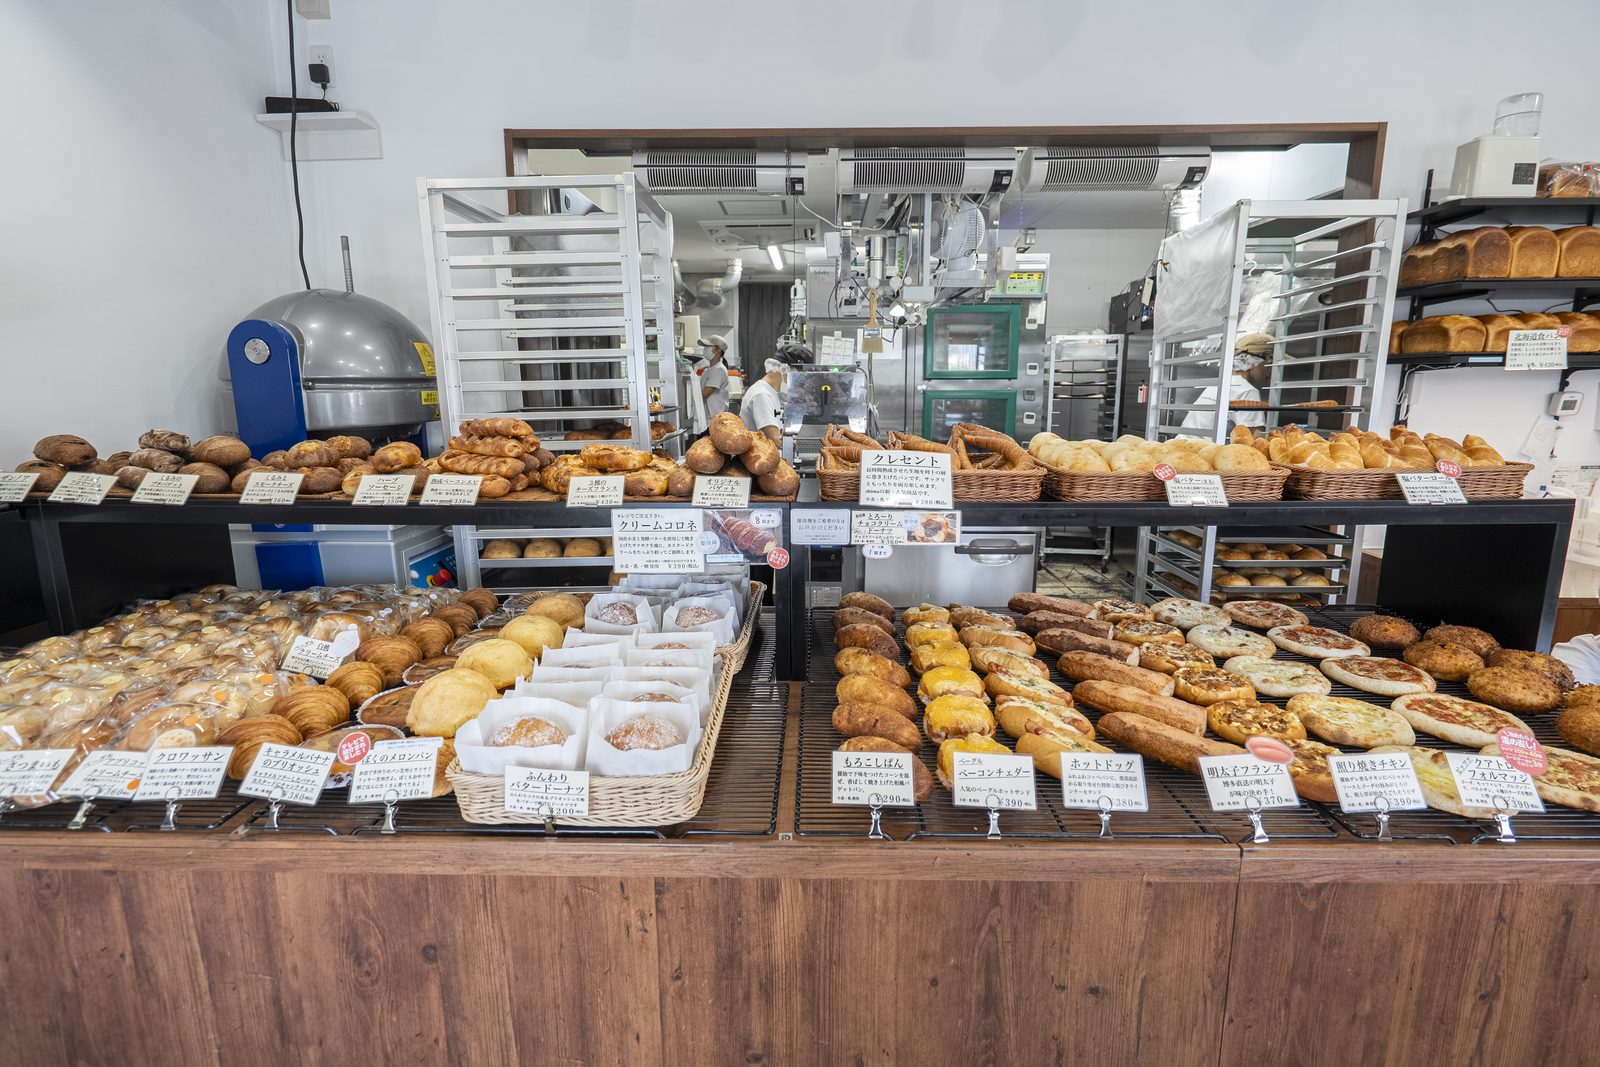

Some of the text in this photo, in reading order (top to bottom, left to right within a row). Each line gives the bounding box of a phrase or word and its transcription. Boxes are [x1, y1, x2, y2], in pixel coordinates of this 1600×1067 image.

[873, 454, 939, 467] クレセント
[619, 520, 697, 531] クリームコロネ
[299, 649, 342, 662] クリームチーズ
[156, 751, 226, 764] クロワッサン
[265, 746, 331, 763] キャラメルバナナ
[362, 752, 433, 765] ぼくのメロンパン
[959, 757, 984, 765] ベーグル
[105, 757, 147, 767] アプリコッ
[262, 758, 320, 775] のブリオッシュ
[1071, 758, 1135, 771] ホットドッグ
[1335, 758, 1408, 773] 照り焼きチキン
[1475, 758, 1514, 770] クアトロ
[526, 771, 568, 784] ふんわり
[958, 767, 1031, 778] ベーコンチェダー
[1207, 764, 1284, 778] 明太子フランス
[1468, 769, 1529, 784] フォルマッジ
[510, 781, 585, 795] バタードーナツ
[1222, 778, 1276, 788] 博多直送の明太子
[960, 786, 1031, 796] 人気のベーグルホットサンド
